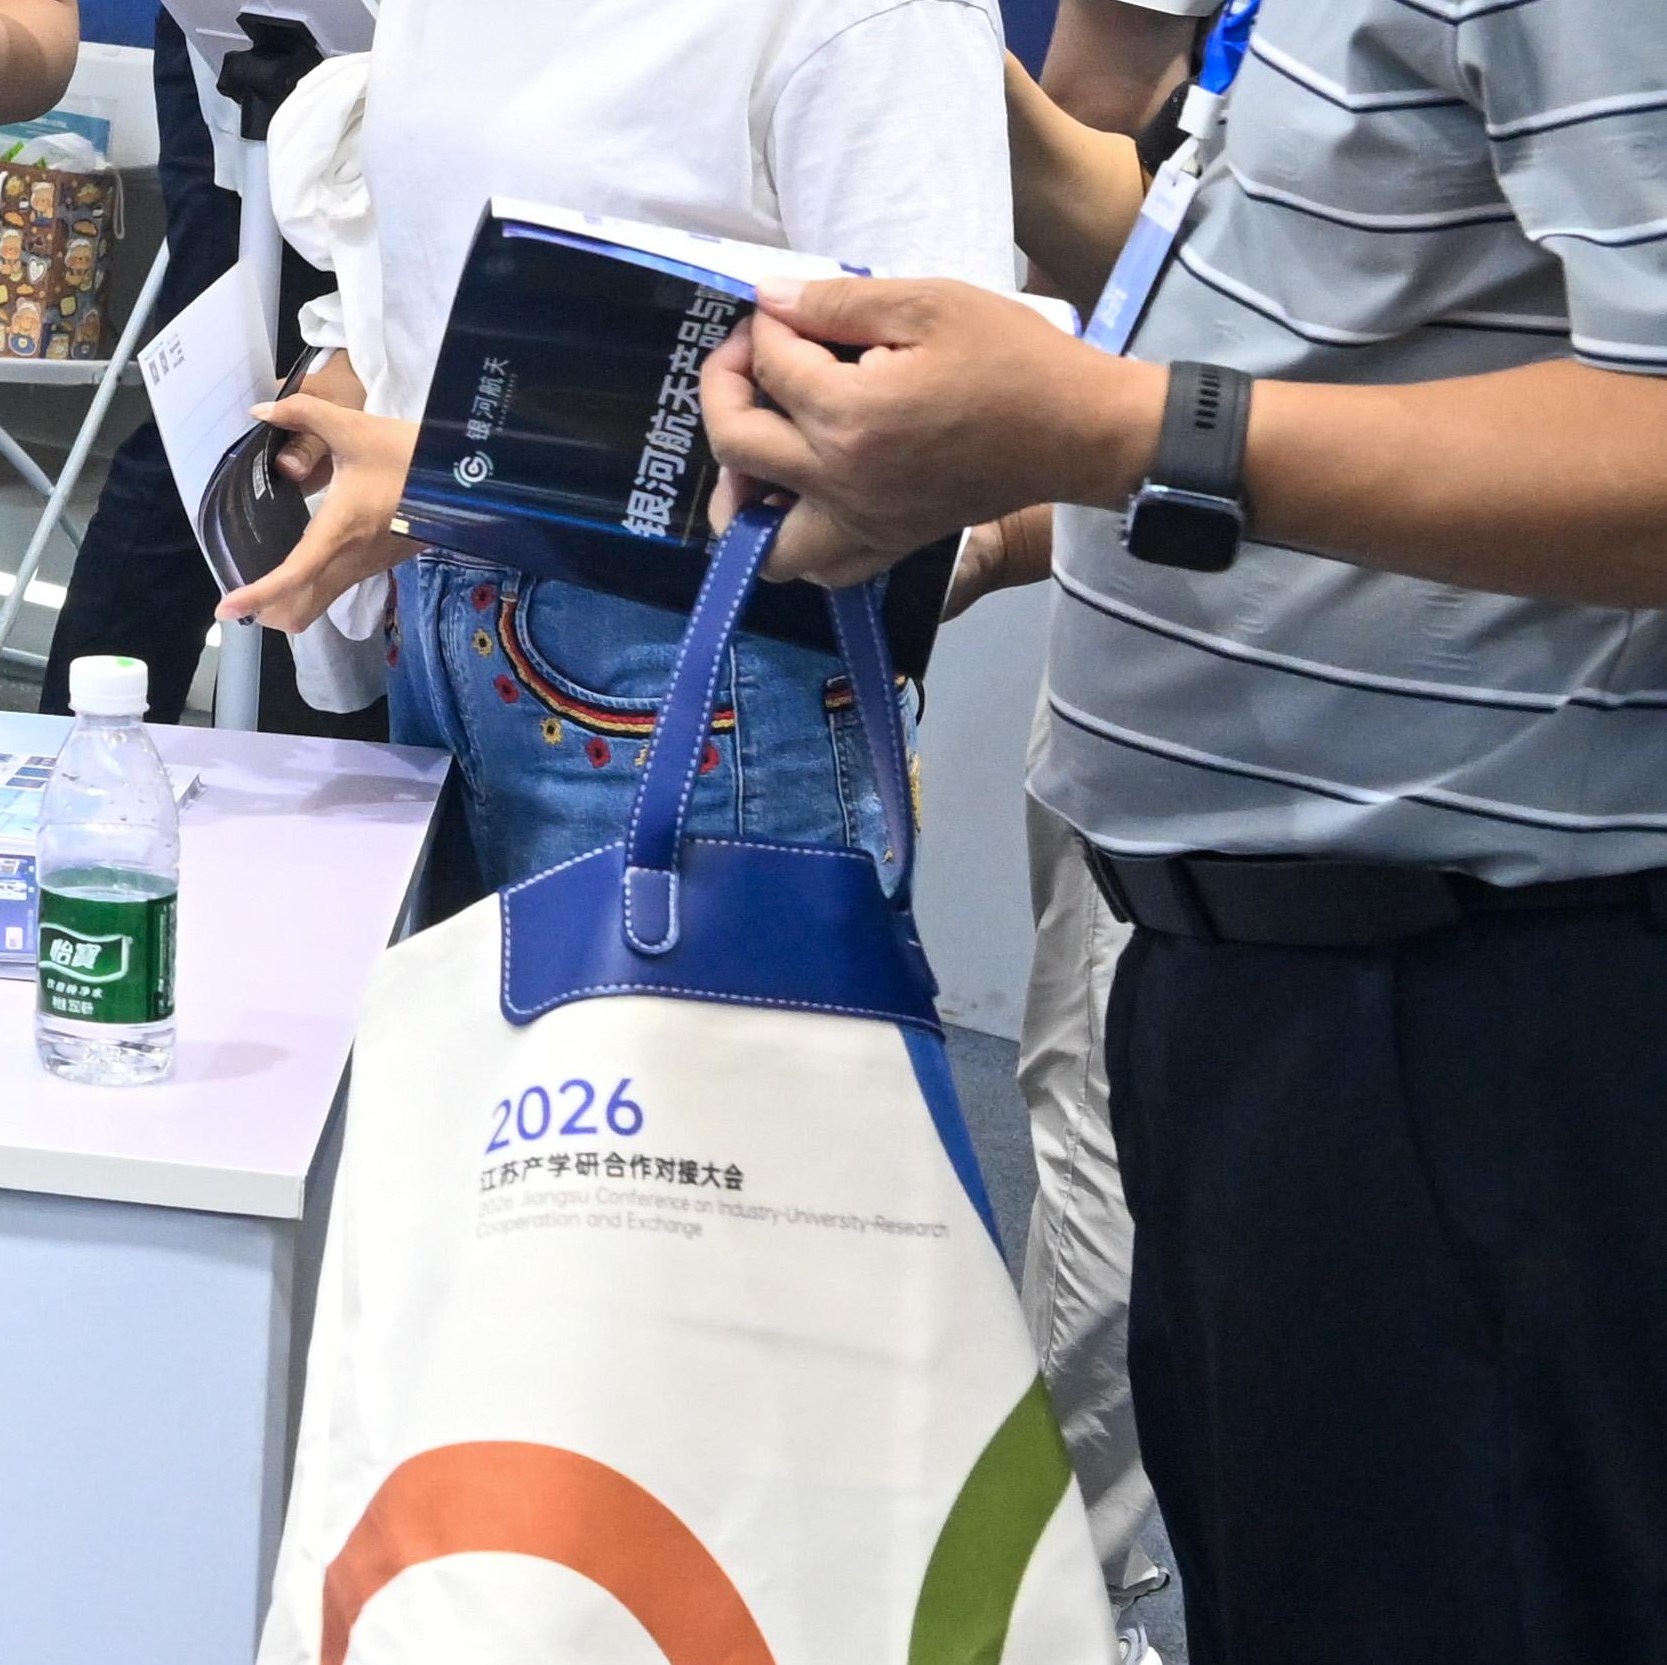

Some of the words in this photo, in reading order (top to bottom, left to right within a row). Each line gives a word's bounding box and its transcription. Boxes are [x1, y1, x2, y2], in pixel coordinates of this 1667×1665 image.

[466, 357, 510, 440] 银河航天
[485, 1078, 644, 1155] 2026
[479, 1151, 744, 1192] 江苏产学研合作对接大会
[595, 1187, 689, 1209] Conference
[694, 1198, 715, 1214] on
[476, 1212, 581, 1239] Cooperation
[586, 1211, 622, 1230] and
[627, 1212, 704, 1240] Exchange
